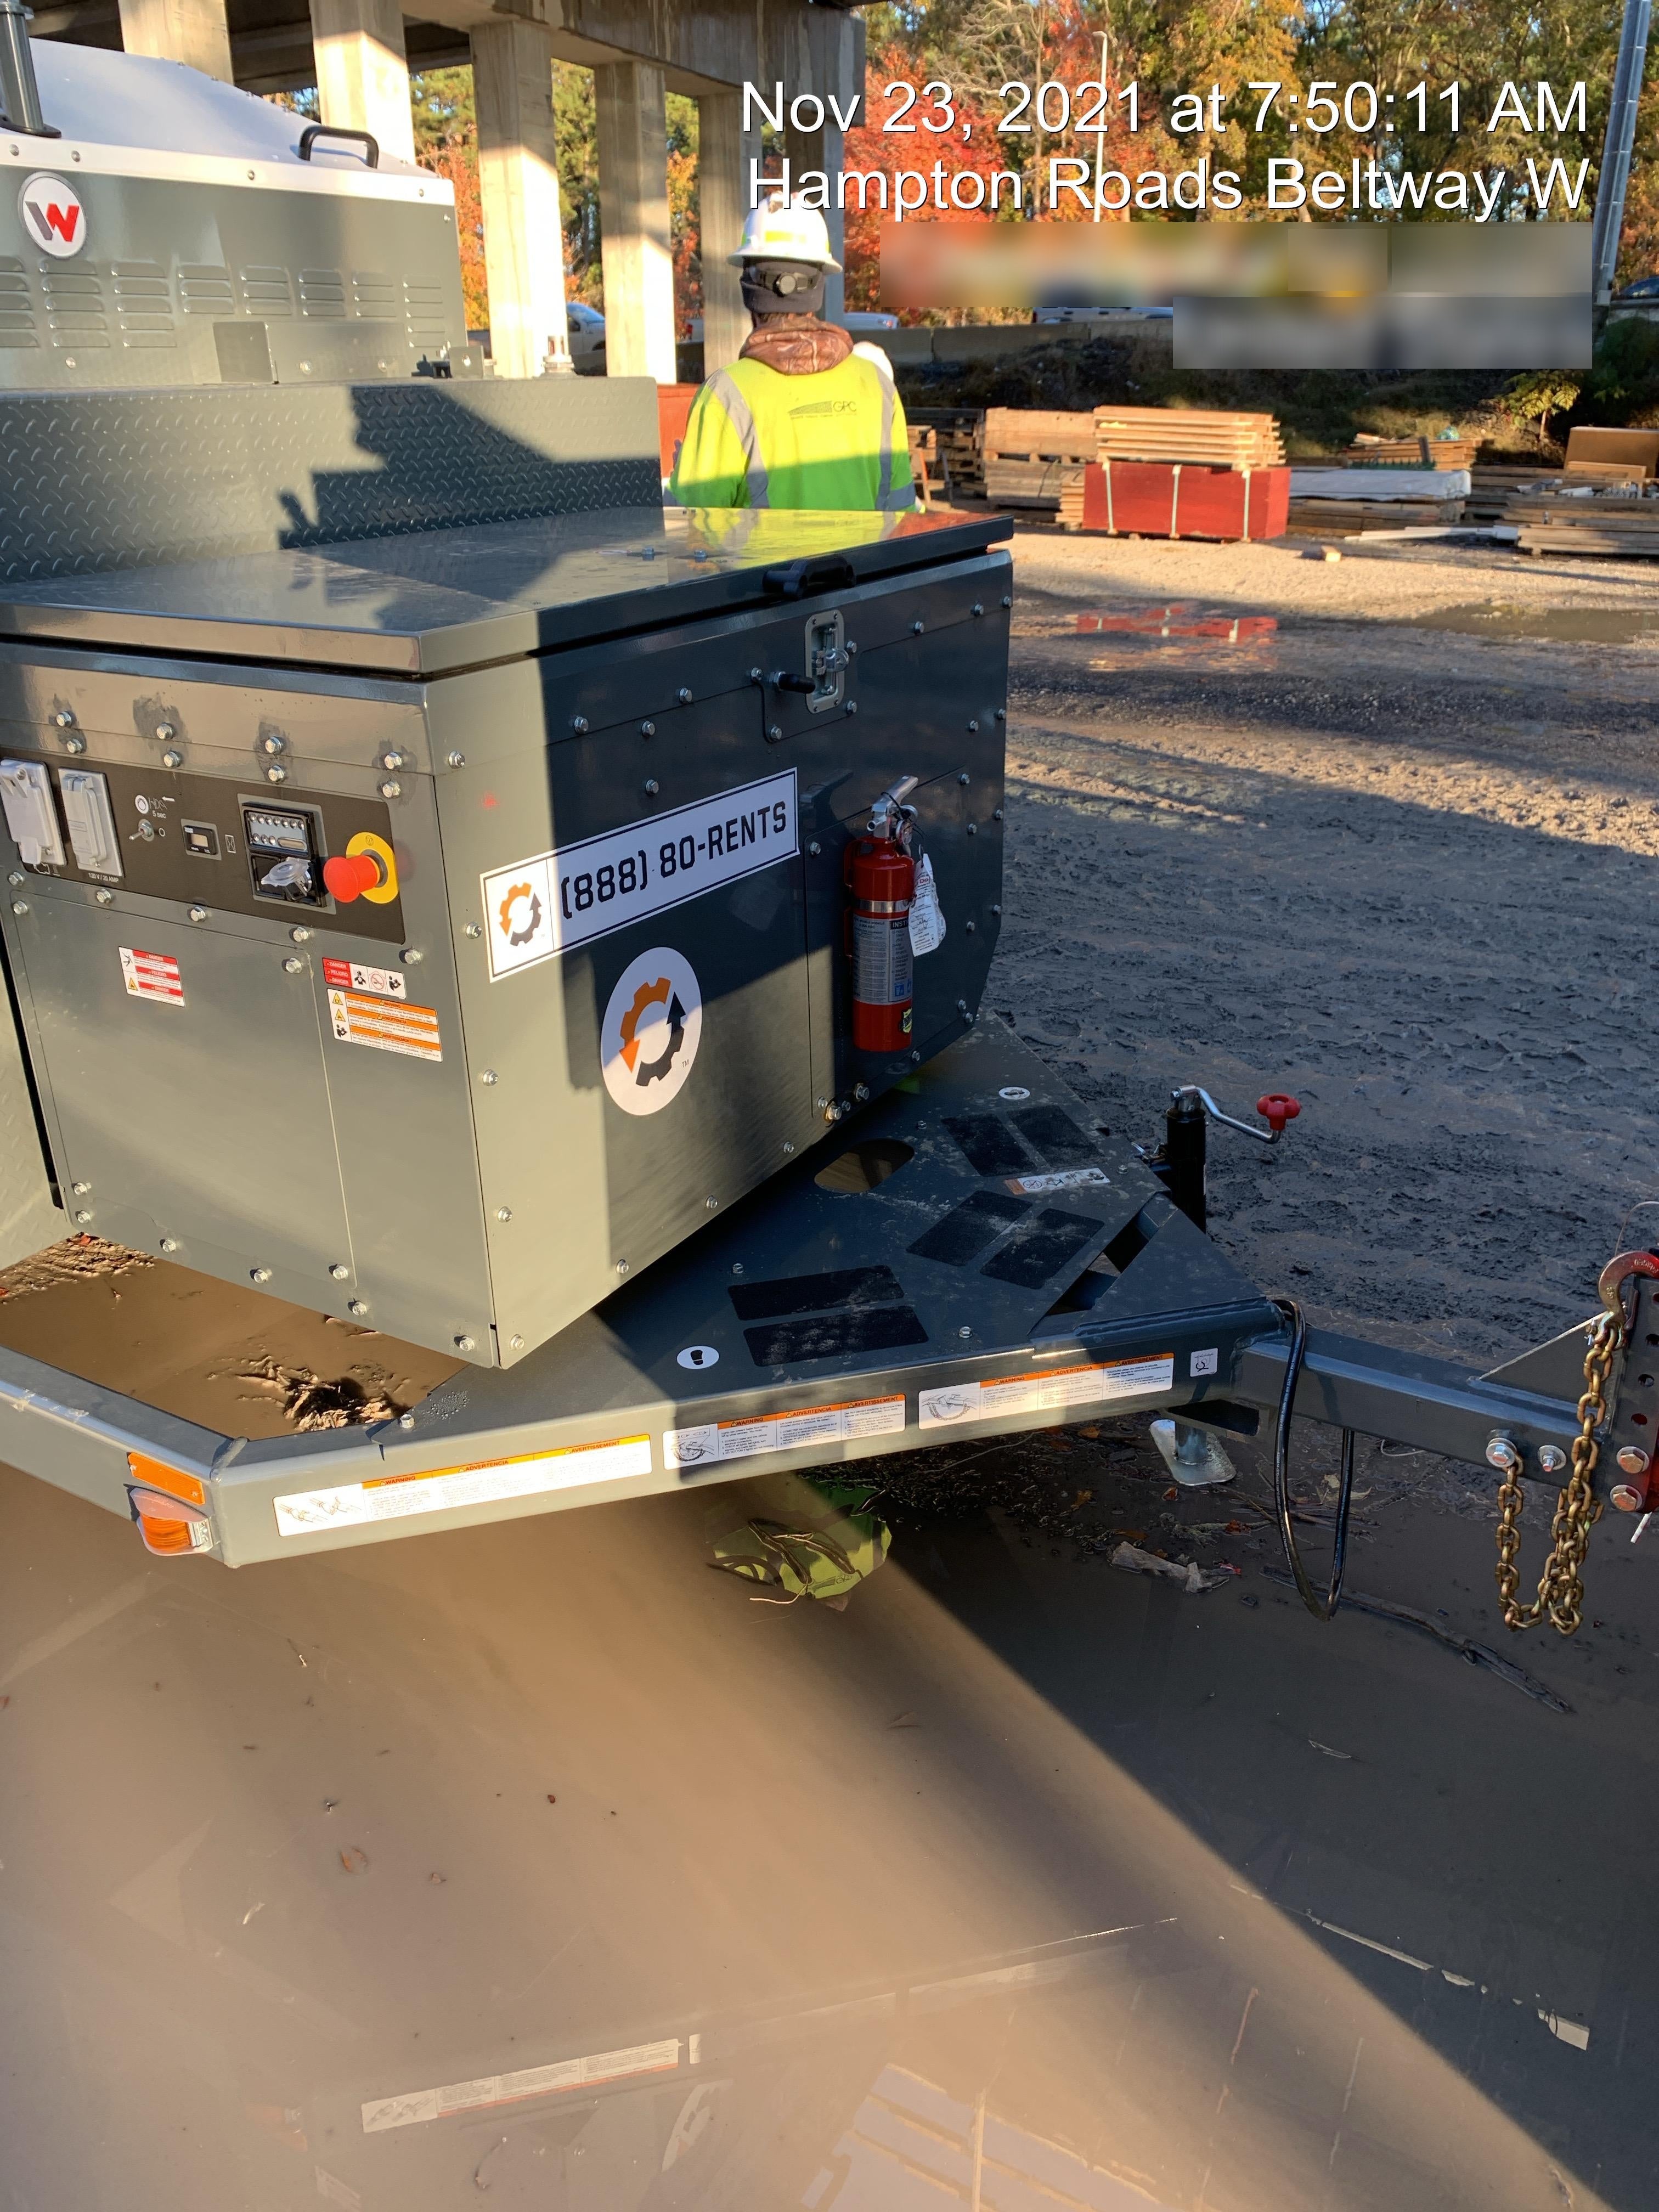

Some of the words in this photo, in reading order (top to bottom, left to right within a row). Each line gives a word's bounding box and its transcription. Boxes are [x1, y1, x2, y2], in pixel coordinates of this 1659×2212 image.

[25, 201, 80, 242] W
[561, 849, 648, 919] (888)
[659, 800, 786, 878] 80-RENTS
[329, 961, 347, 969] DANGER
[330, 969, 349, 977] PELIGRO
[332, 977, 349, 985] DANGER
[1056, 1365, 1093, 1375] ADVERTENCIA
[855, 1396, 899, 1407] AVERTISSEMENT
[793, 1407, 832, 1417] ADVERTENCIA
[736, 1417, 764, 1426] WARNING
[571, 1440, 620, 1454] AVERTISSEMENT
[465, 1459, 509, 1472] ADVERTENCIA
[385, 1475, 416, 1486] WARNING
